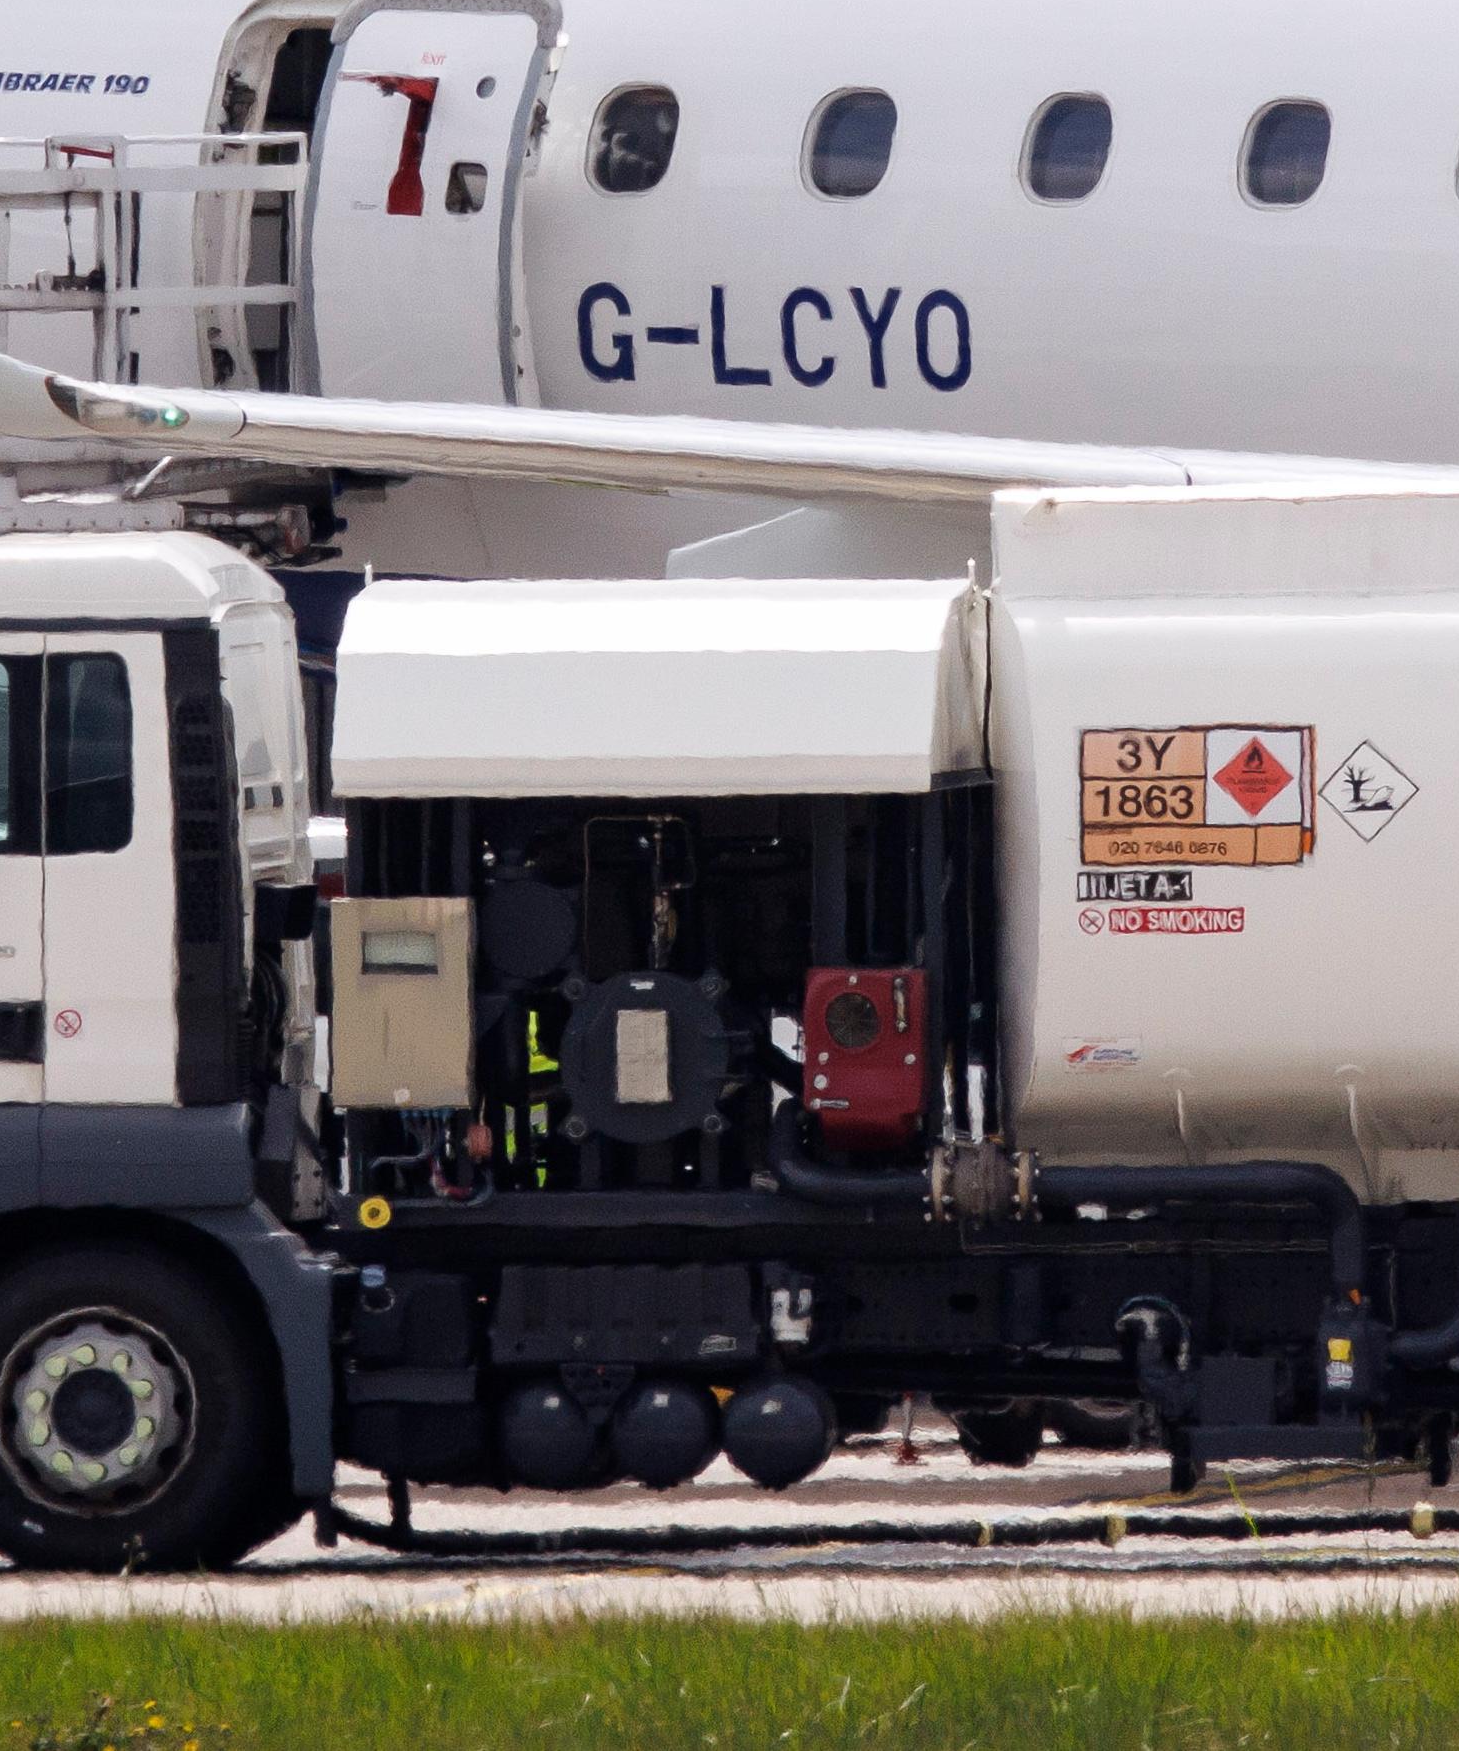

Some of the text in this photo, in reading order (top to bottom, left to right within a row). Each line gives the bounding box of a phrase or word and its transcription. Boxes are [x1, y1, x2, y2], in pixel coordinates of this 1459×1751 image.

[103, 74, 150, 95] 190
[576, 281, 972, 393] G-LCYO
[1116, 735, 1176, 772] 3Y
[1095, 784, 1194, 819] 1863
[1108, 841, 1140, 856] 020
[1108, 874, 1191, 899] JET A-1
[1111, 909, 1243, 932] NO SMOKING
